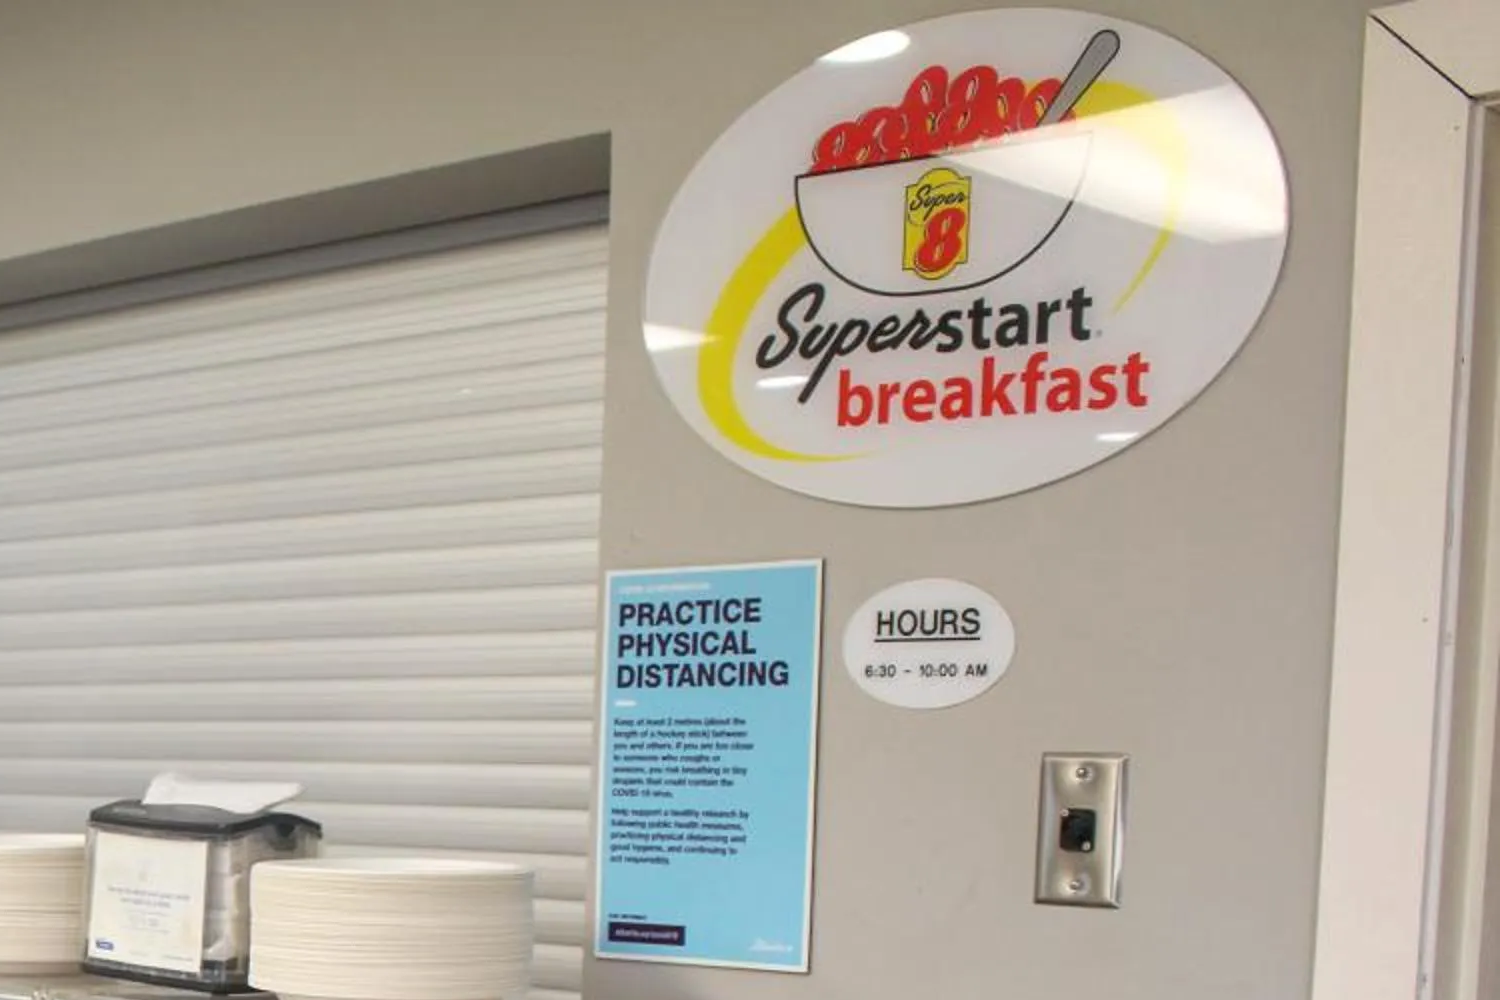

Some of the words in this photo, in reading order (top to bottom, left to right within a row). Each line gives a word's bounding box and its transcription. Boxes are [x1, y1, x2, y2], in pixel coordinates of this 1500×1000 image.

[910, 184, 965, 221] Super
[914, 206, 966, 273] 8
[756, 282, 1093, 404] Superstart
[837, 352, 1150, 427] breakfast
[619, 597, 762, 627] PRACTICE
[876, 608, 981, 636] HOURS
[618, 630, 756, 658] PHYSICAL
[617, 660, 789, 688] DISTANCING
[865, 664, 897, 677] 6:30
[919, 663, 958, 677] 10:00
[965, 663, 988, 676] AM
